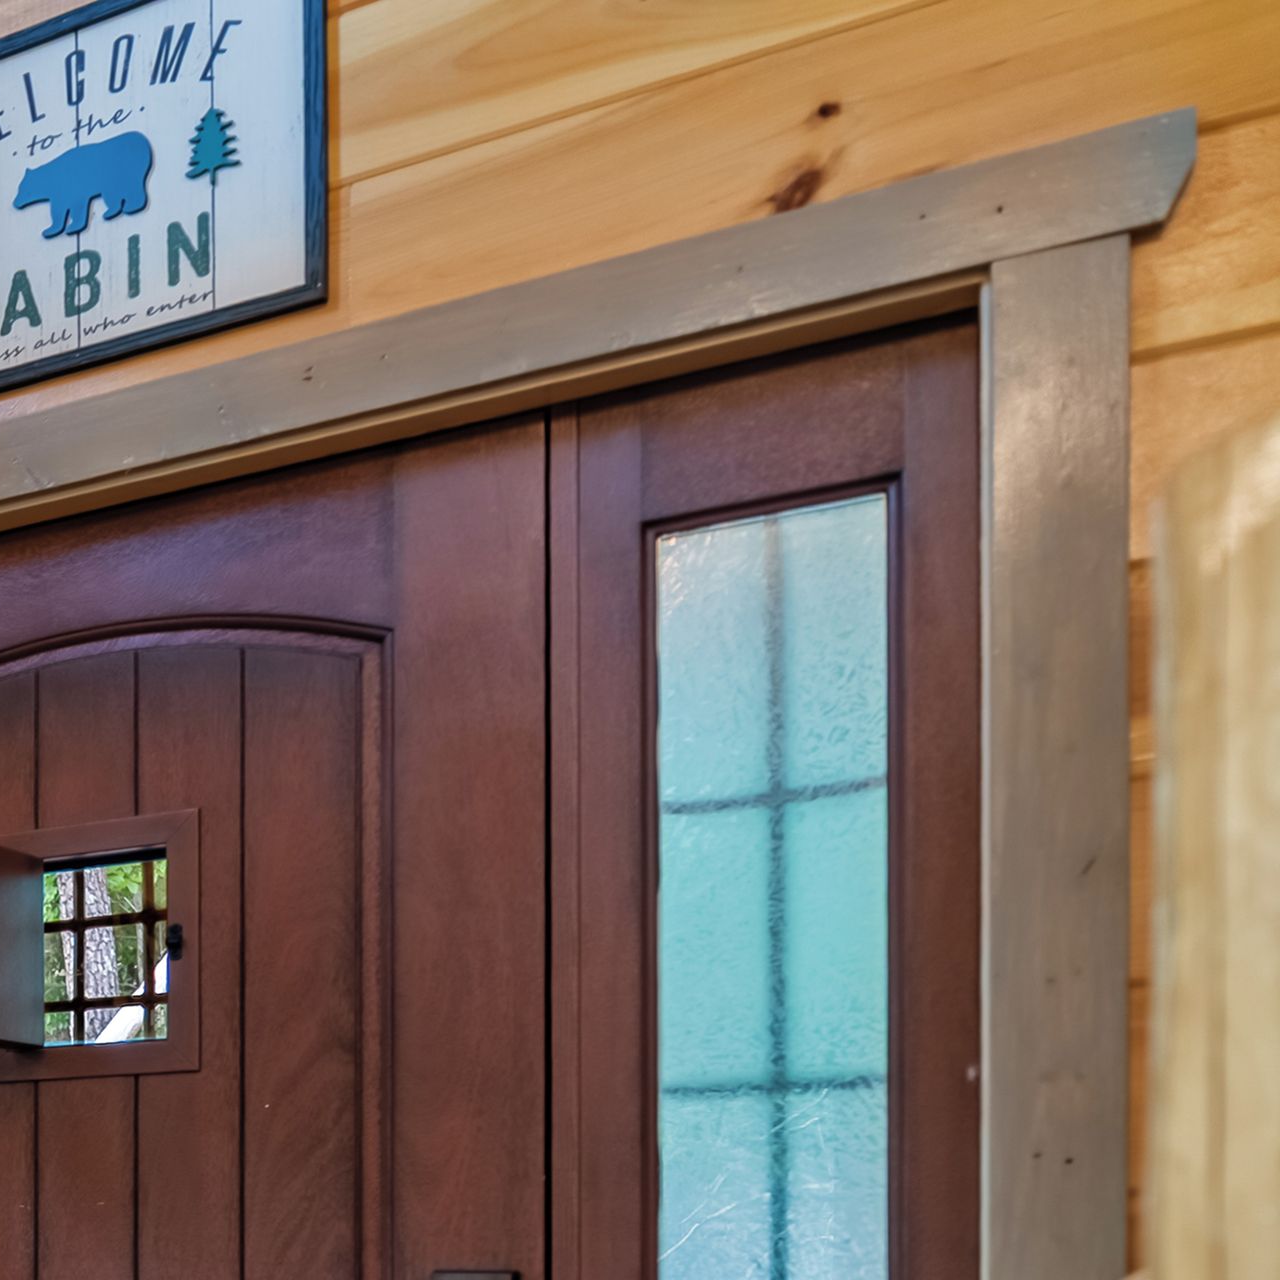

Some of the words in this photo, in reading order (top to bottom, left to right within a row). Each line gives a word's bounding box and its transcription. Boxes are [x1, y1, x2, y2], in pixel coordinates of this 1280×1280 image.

[27, 132, 62, 157] to
[71, 107, 133, 141] the
[33, 329, 72, 350] all
[82, 312, 136, 337] who
[145, 289, 215, 317] enter
